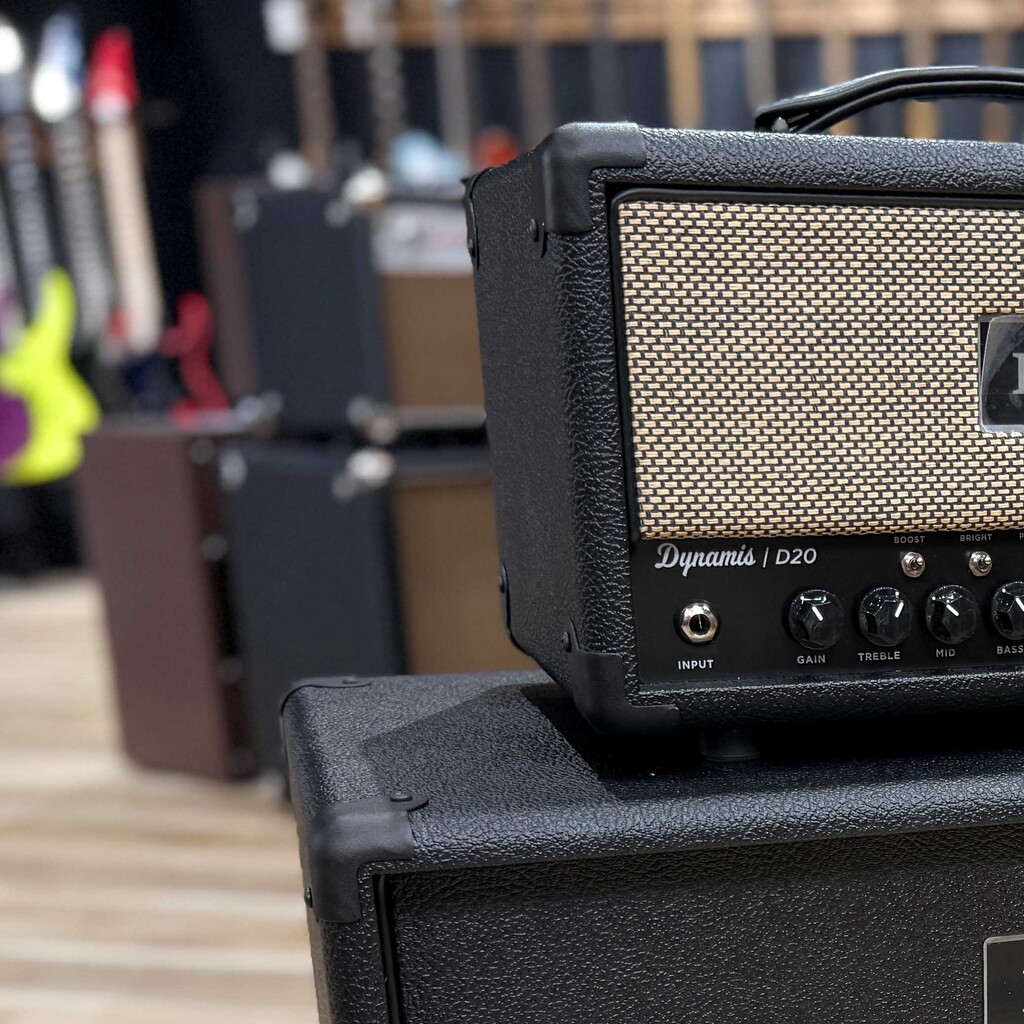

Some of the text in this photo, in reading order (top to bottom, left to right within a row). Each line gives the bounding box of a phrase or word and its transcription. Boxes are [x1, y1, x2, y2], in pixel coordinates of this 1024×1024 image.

[894, 535, 926, 544] BOOST
[960, 533, 993, 542] BRIGHT
[654, 542, 756, 577] Dynamis
[775, 547, 818, 565] D20
[936, 648, 956, 658] MID
[996, 644, 1024, 655] BASS
[796, 654, 826, 664] GAIN
[858, 651, 900, 661] TREBLE
[678, 659, 714, 670] INPUT
